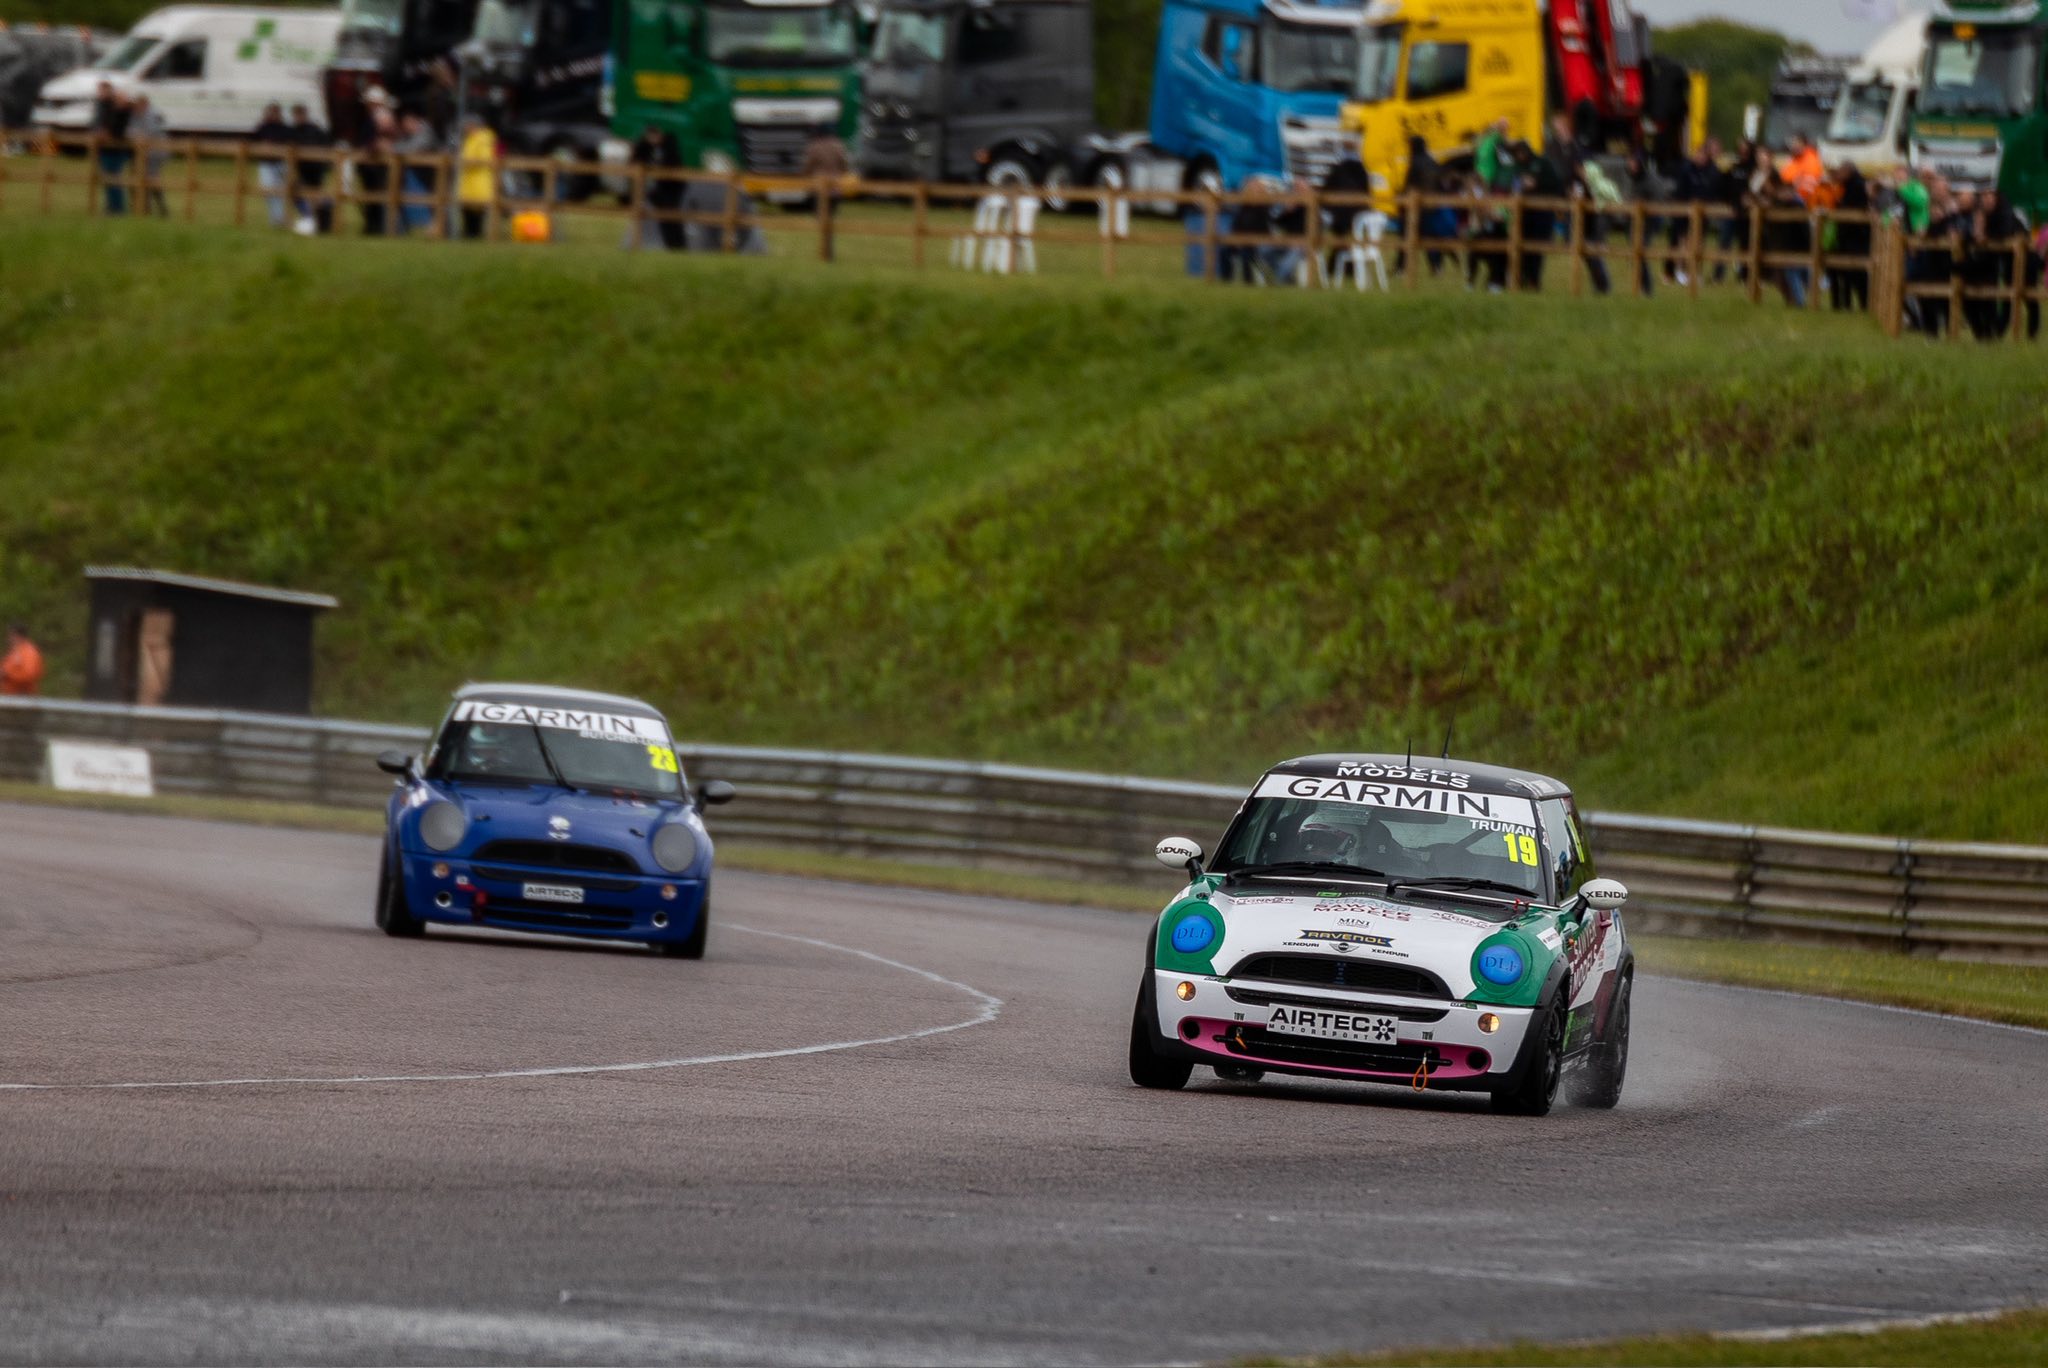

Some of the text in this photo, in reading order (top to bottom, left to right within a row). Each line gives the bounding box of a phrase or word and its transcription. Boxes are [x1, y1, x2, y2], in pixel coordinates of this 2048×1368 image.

[481, 704, 637, 734] GARMIN
[1336, 767, 1470, 789] MODELS
[1339, 761, 1471, 779] SAWYER
[1287, 777, 1491, 818] GARMIN
[1469, 819, 1537, 839] TRUMAN
[1503, 833, 1538, 867] 19
[527, 886, 571, 897] AIRTEC
[1338, 917, 1371, 927] MINI
[1307, 931, 1388, 945] RAVENOL
[1371, 948, 1410, 958] XENDURI
[1234, 1011, 1245, 1021] TOW
[1269, 1007, 1371, 1033] AIRTEC
[1268, 1023, 1369, 1040] MOTORSPORT
[1422, 1030, 1434, 1041] TOW
